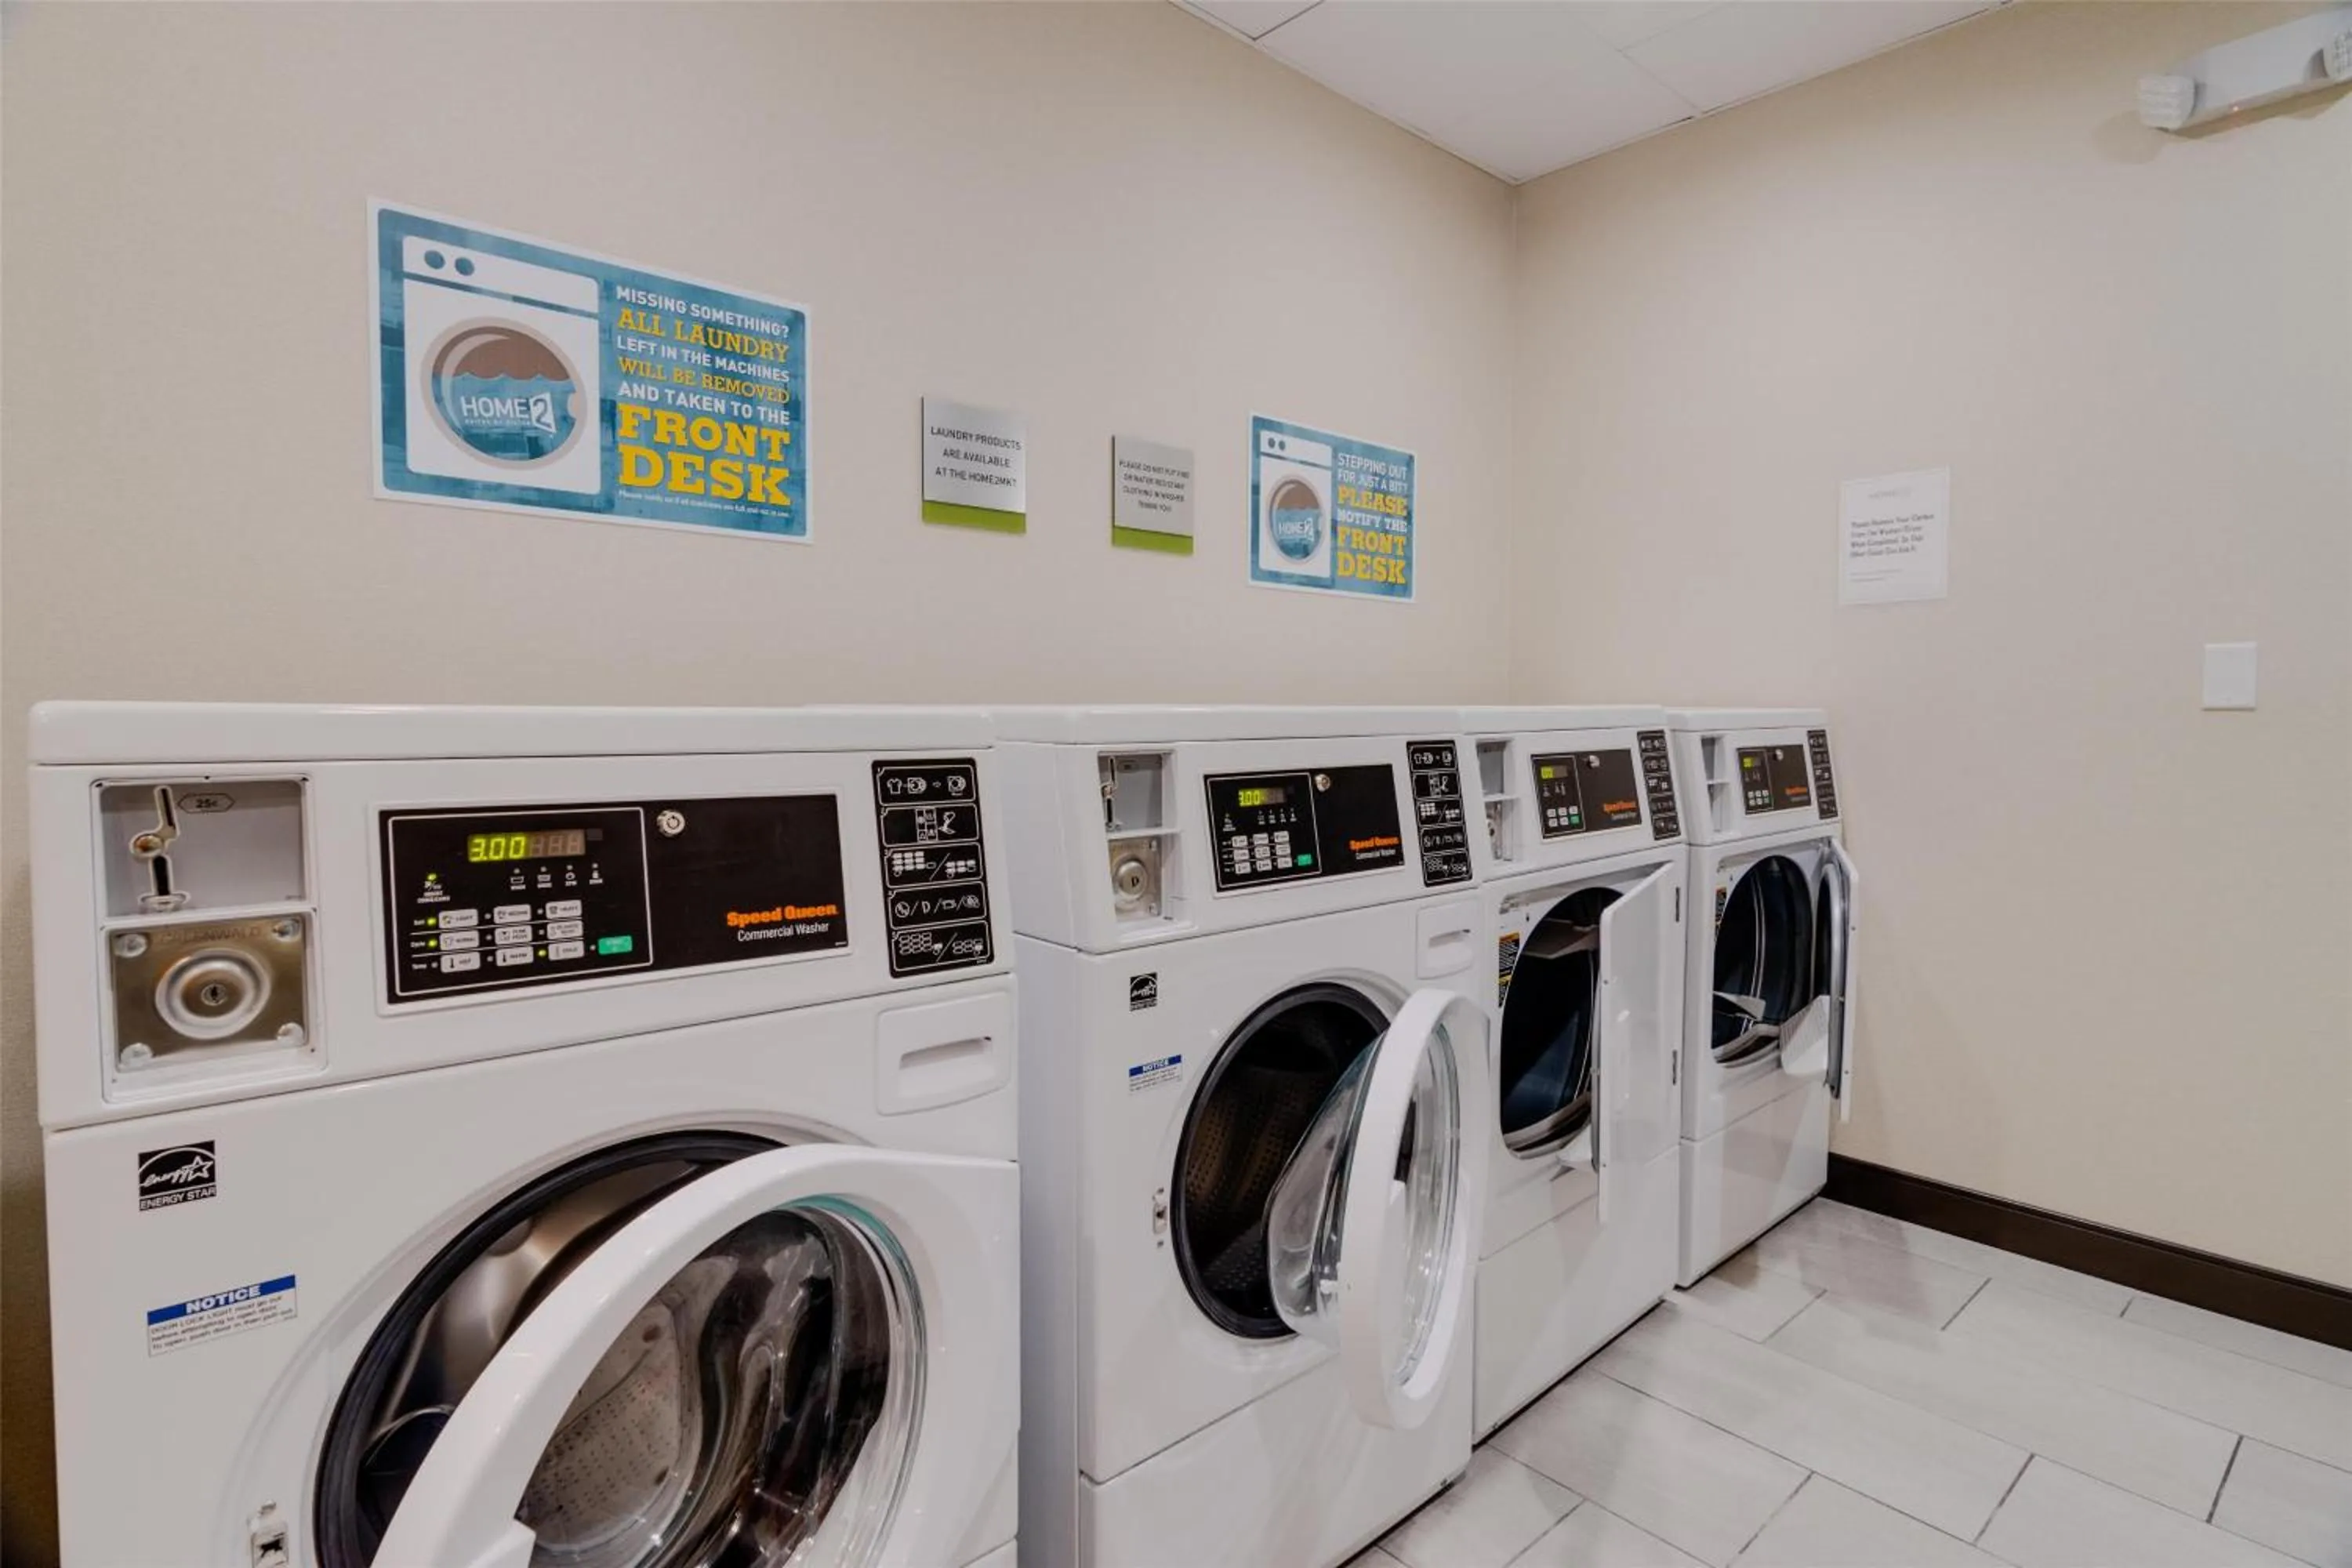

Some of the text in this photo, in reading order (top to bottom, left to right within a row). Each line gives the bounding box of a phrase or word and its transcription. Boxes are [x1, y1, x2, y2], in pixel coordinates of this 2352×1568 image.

[616, 285, 789, 338] MISSING SOMETHING?
[618, 307, 789, 364] ALL LAUNDRY
[617, 336, 790, 382] LEFT IN THE MACHINES
[619, 358, 789, 404] WILL BE REMOVED
[618, 382, 790, 425] AND TAKEN TO THE
[618, 402, 790, 462] FRONT
[931, 426, 1022, 450] LAUNDRY PRODUCTS
[943, 448, 1011, 468] ARE AVAILABLE
[1338, 452, 1407, 480] STEPPING OUT
[618, 443, 790, 506] DESK
[935, 466, 946, 477] AT
[948, 468, 967, 481] THE
[1338, 468, 1356, 484] FOR
[1381, 478, 1387, 490] A
[1338, 485, 1408, 516] PLEASE
[1338, 508, 1408, 534] NOTIFY THE
[1338, 526, 1406, 556] FRONT
[1338, 551, 1406, 585] DESK
[470, 836, 526, 862] 3.00
[726, 904, 837, 927] Speed Queen
[738, 922, 829, 942] Commercial Washer
[1142, 1058, 1169, 1073] NOTICE
[140, 1186, 216, 1210] ENERGY STAR
[186, 1285, 261, 1316] NOTICE
